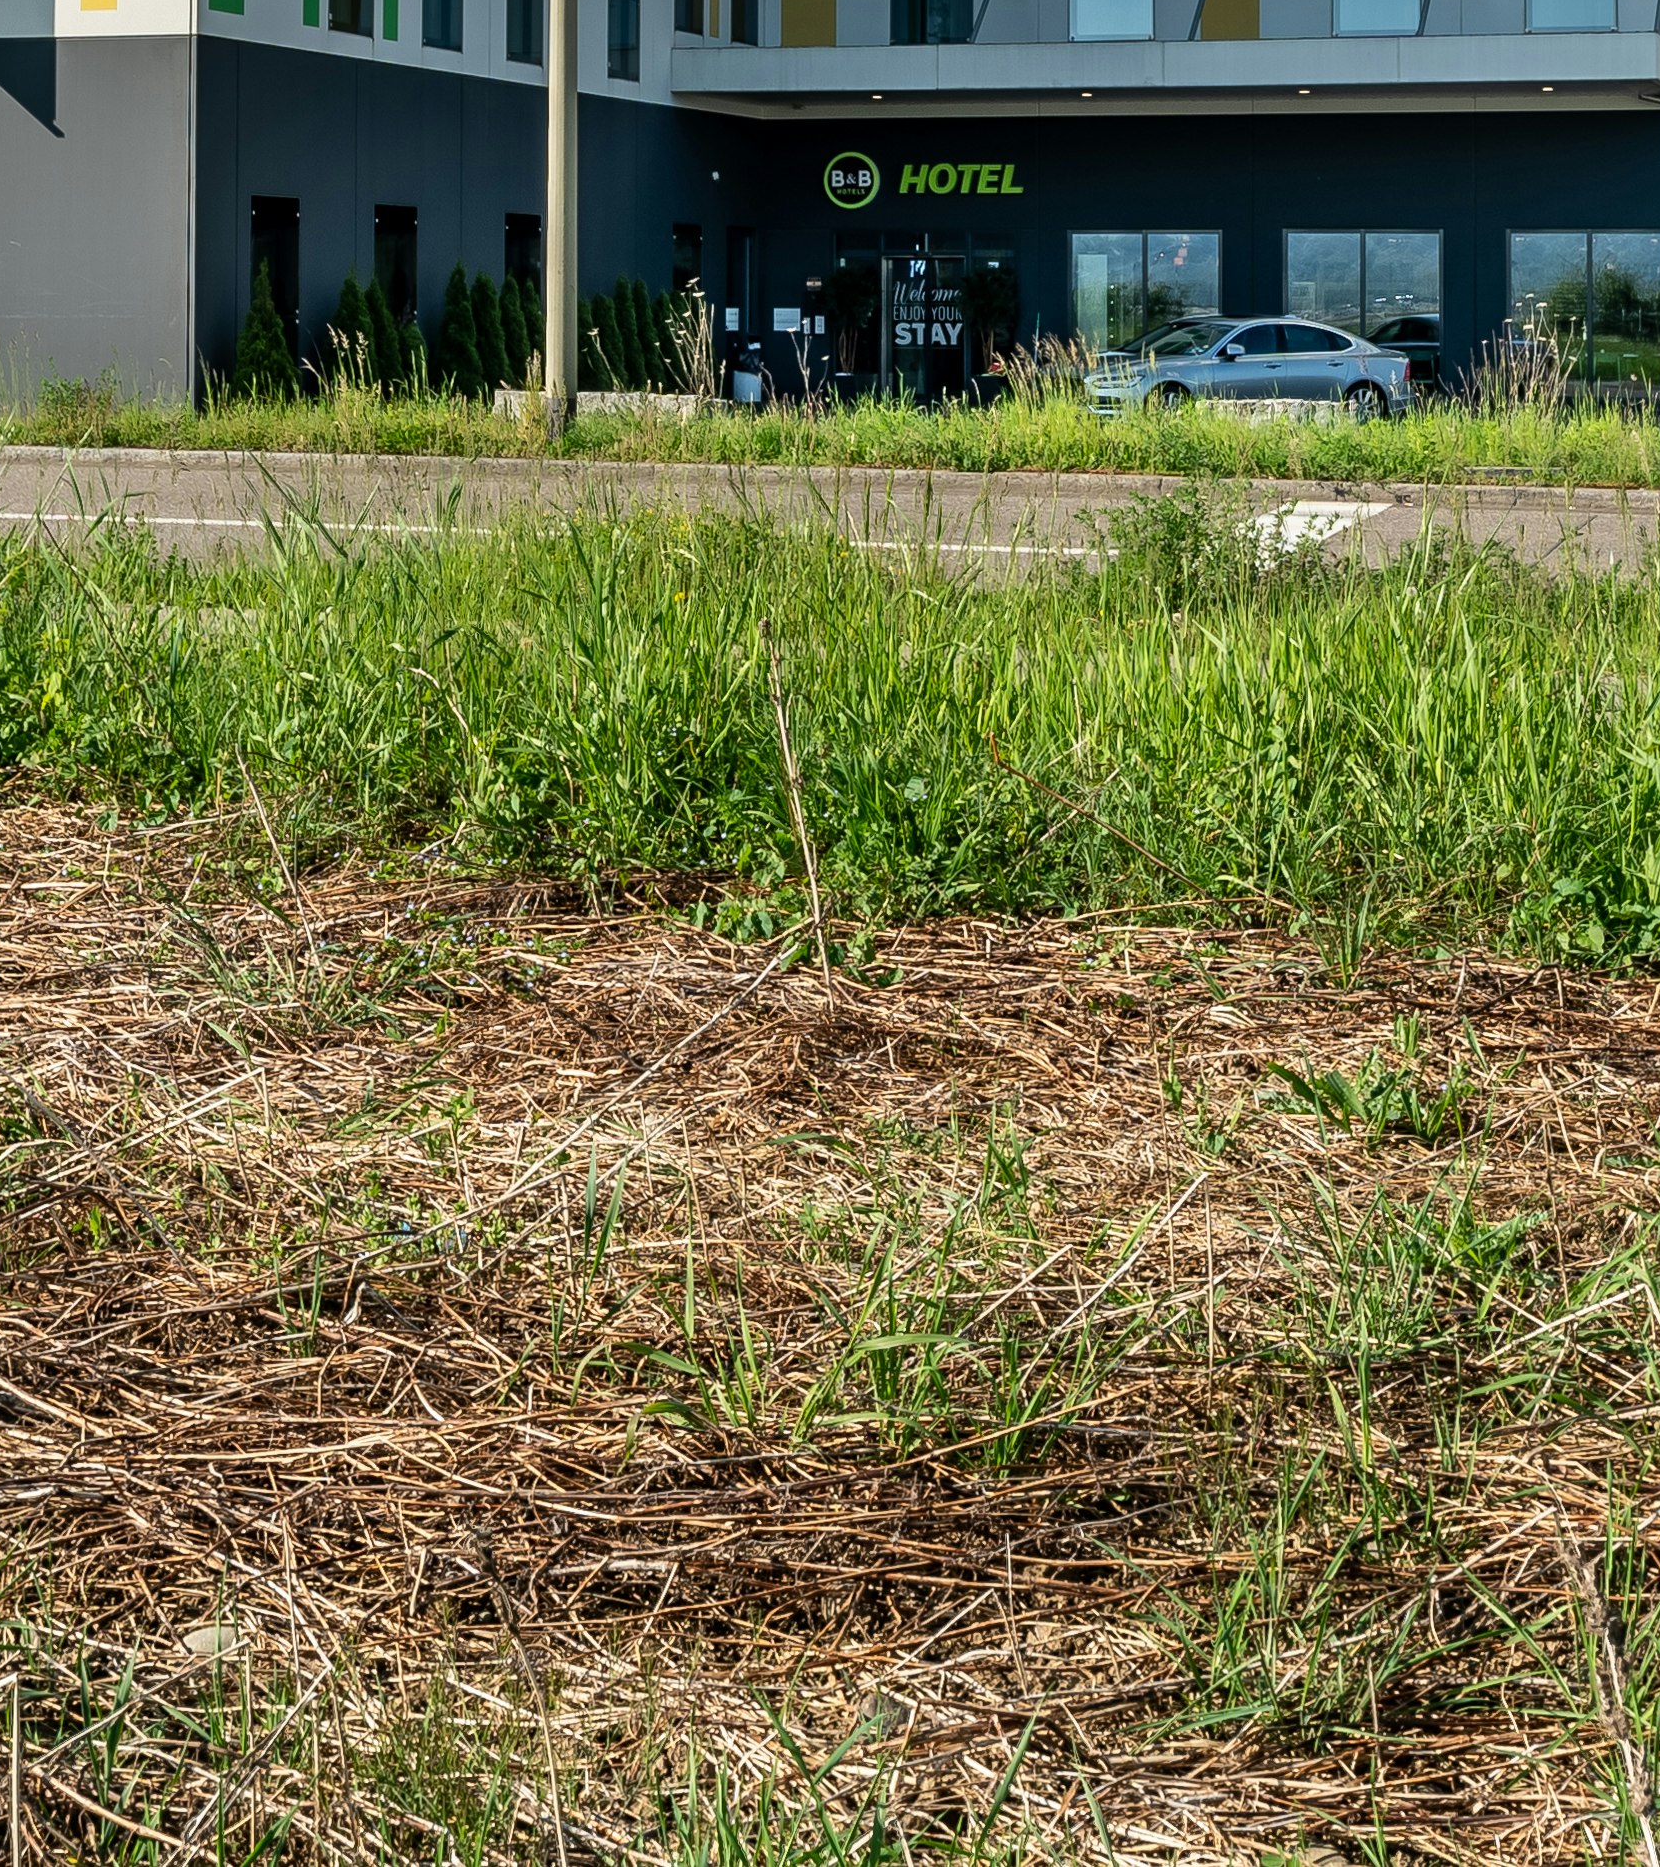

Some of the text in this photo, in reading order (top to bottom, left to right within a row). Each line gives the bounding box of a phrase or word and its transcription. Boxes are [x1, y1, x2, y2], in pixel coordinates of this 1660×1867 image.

[831, 163, 1024, 194] B&B HOTEL
[893, 305, 926, 321] ENJOY
[894, 322, 963, 346] STAY
